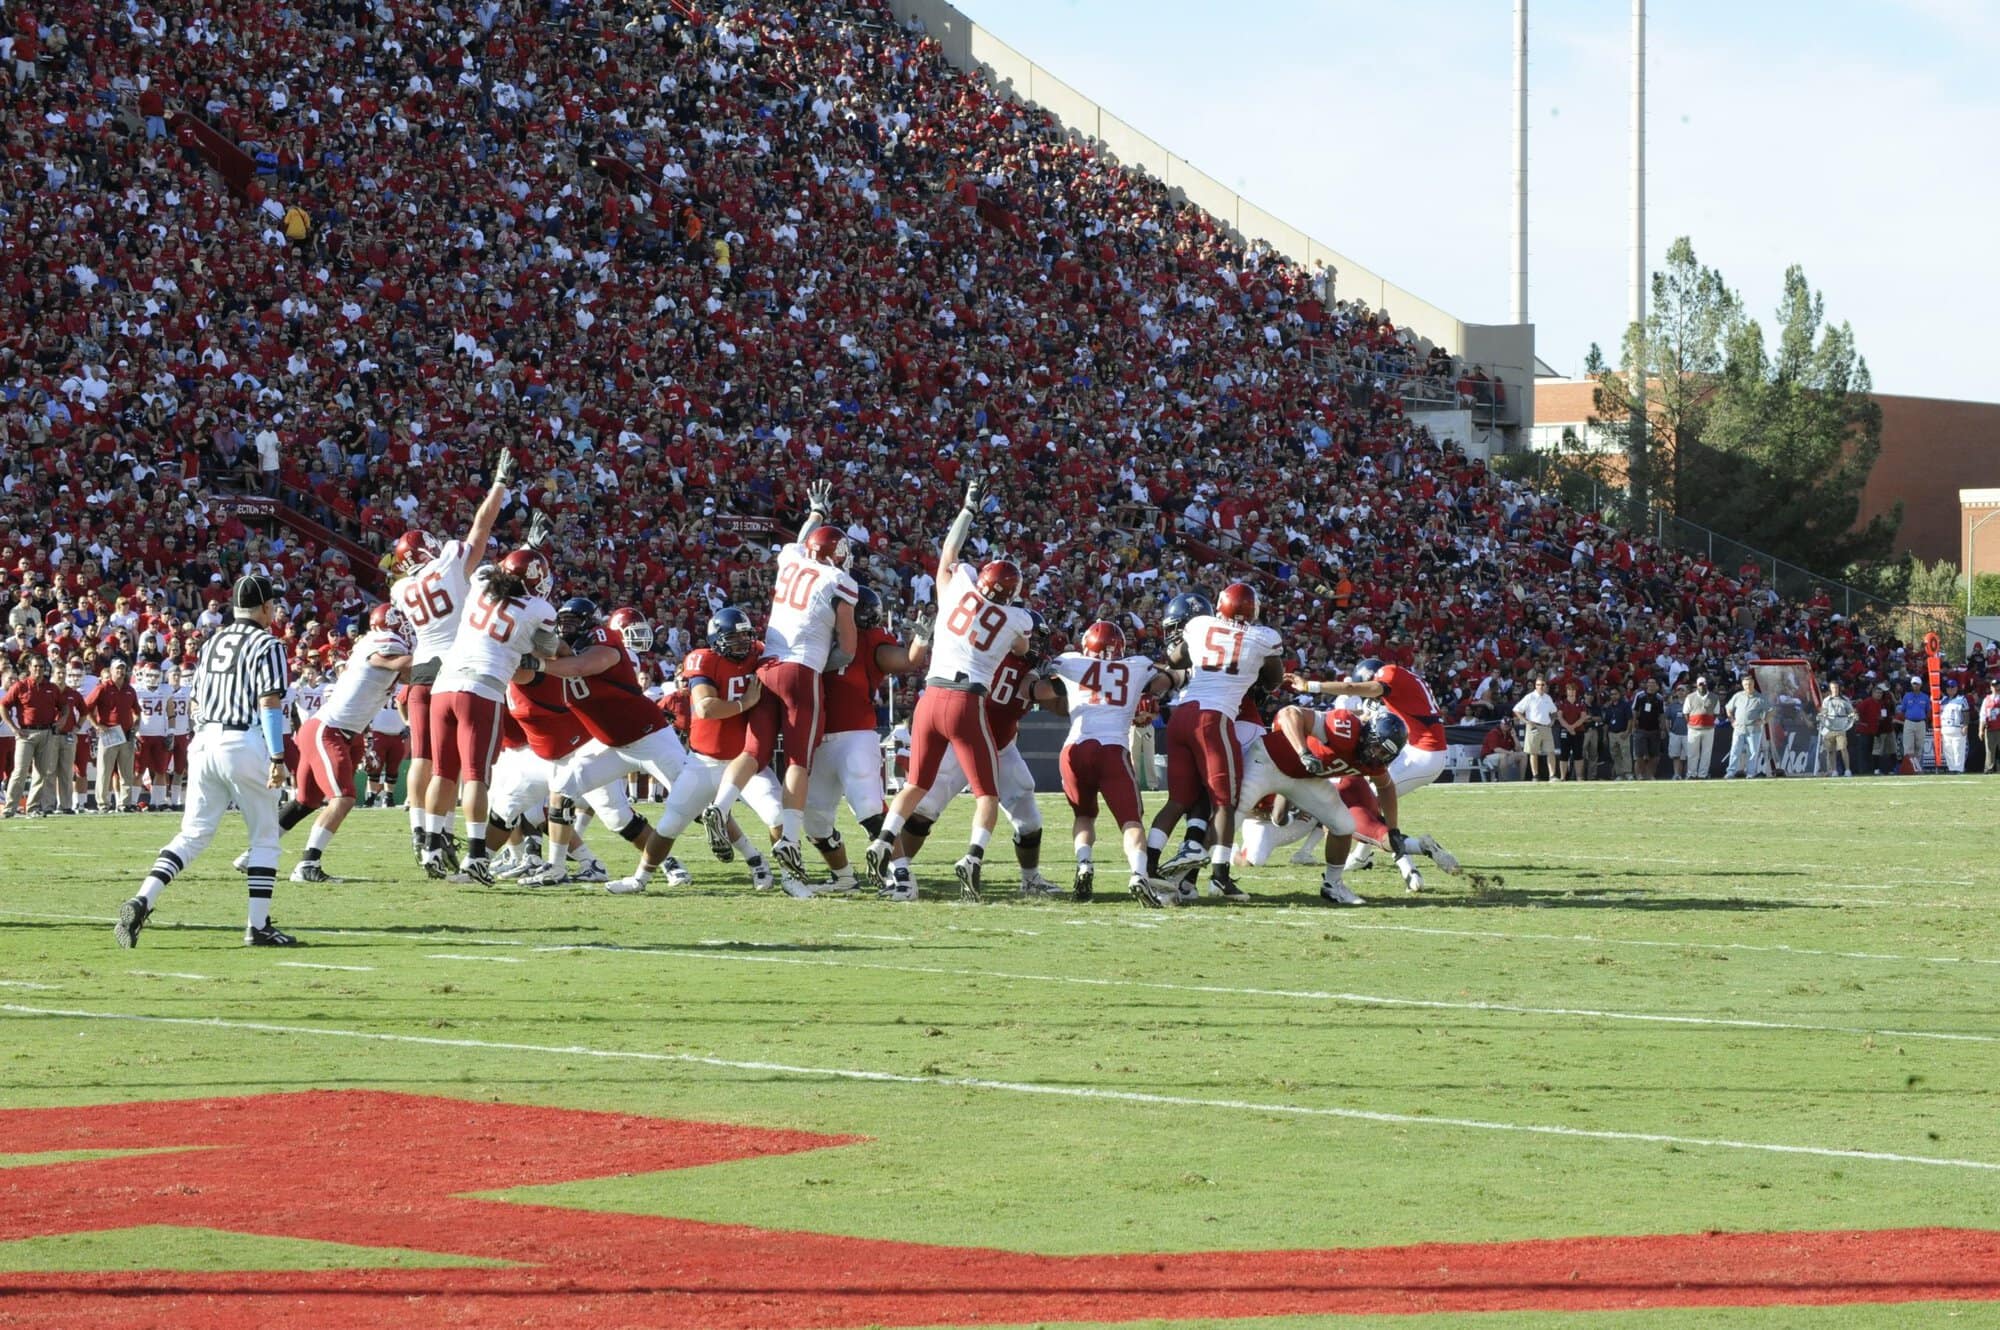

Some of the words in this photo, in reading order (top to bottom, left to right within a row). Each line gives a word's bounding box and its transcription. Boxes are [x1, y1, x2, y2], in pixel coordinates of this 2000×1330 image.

[231, 504, 259, 514] ECTION
[404, 571, 453, 627] 96
[774, 562, 819, 611] 90
[469, 592, 527, 643] 95
[947, 591, 1008, 652] 89
[211, 634, 242, 672] S
[687, 653, 703, 671] 67
[1201, 626, 1245, 675] 51
[304, 695, 321, 710] 74
[1079, 661, 1129, 707] 43
[143, 700, 163, 716] 54
